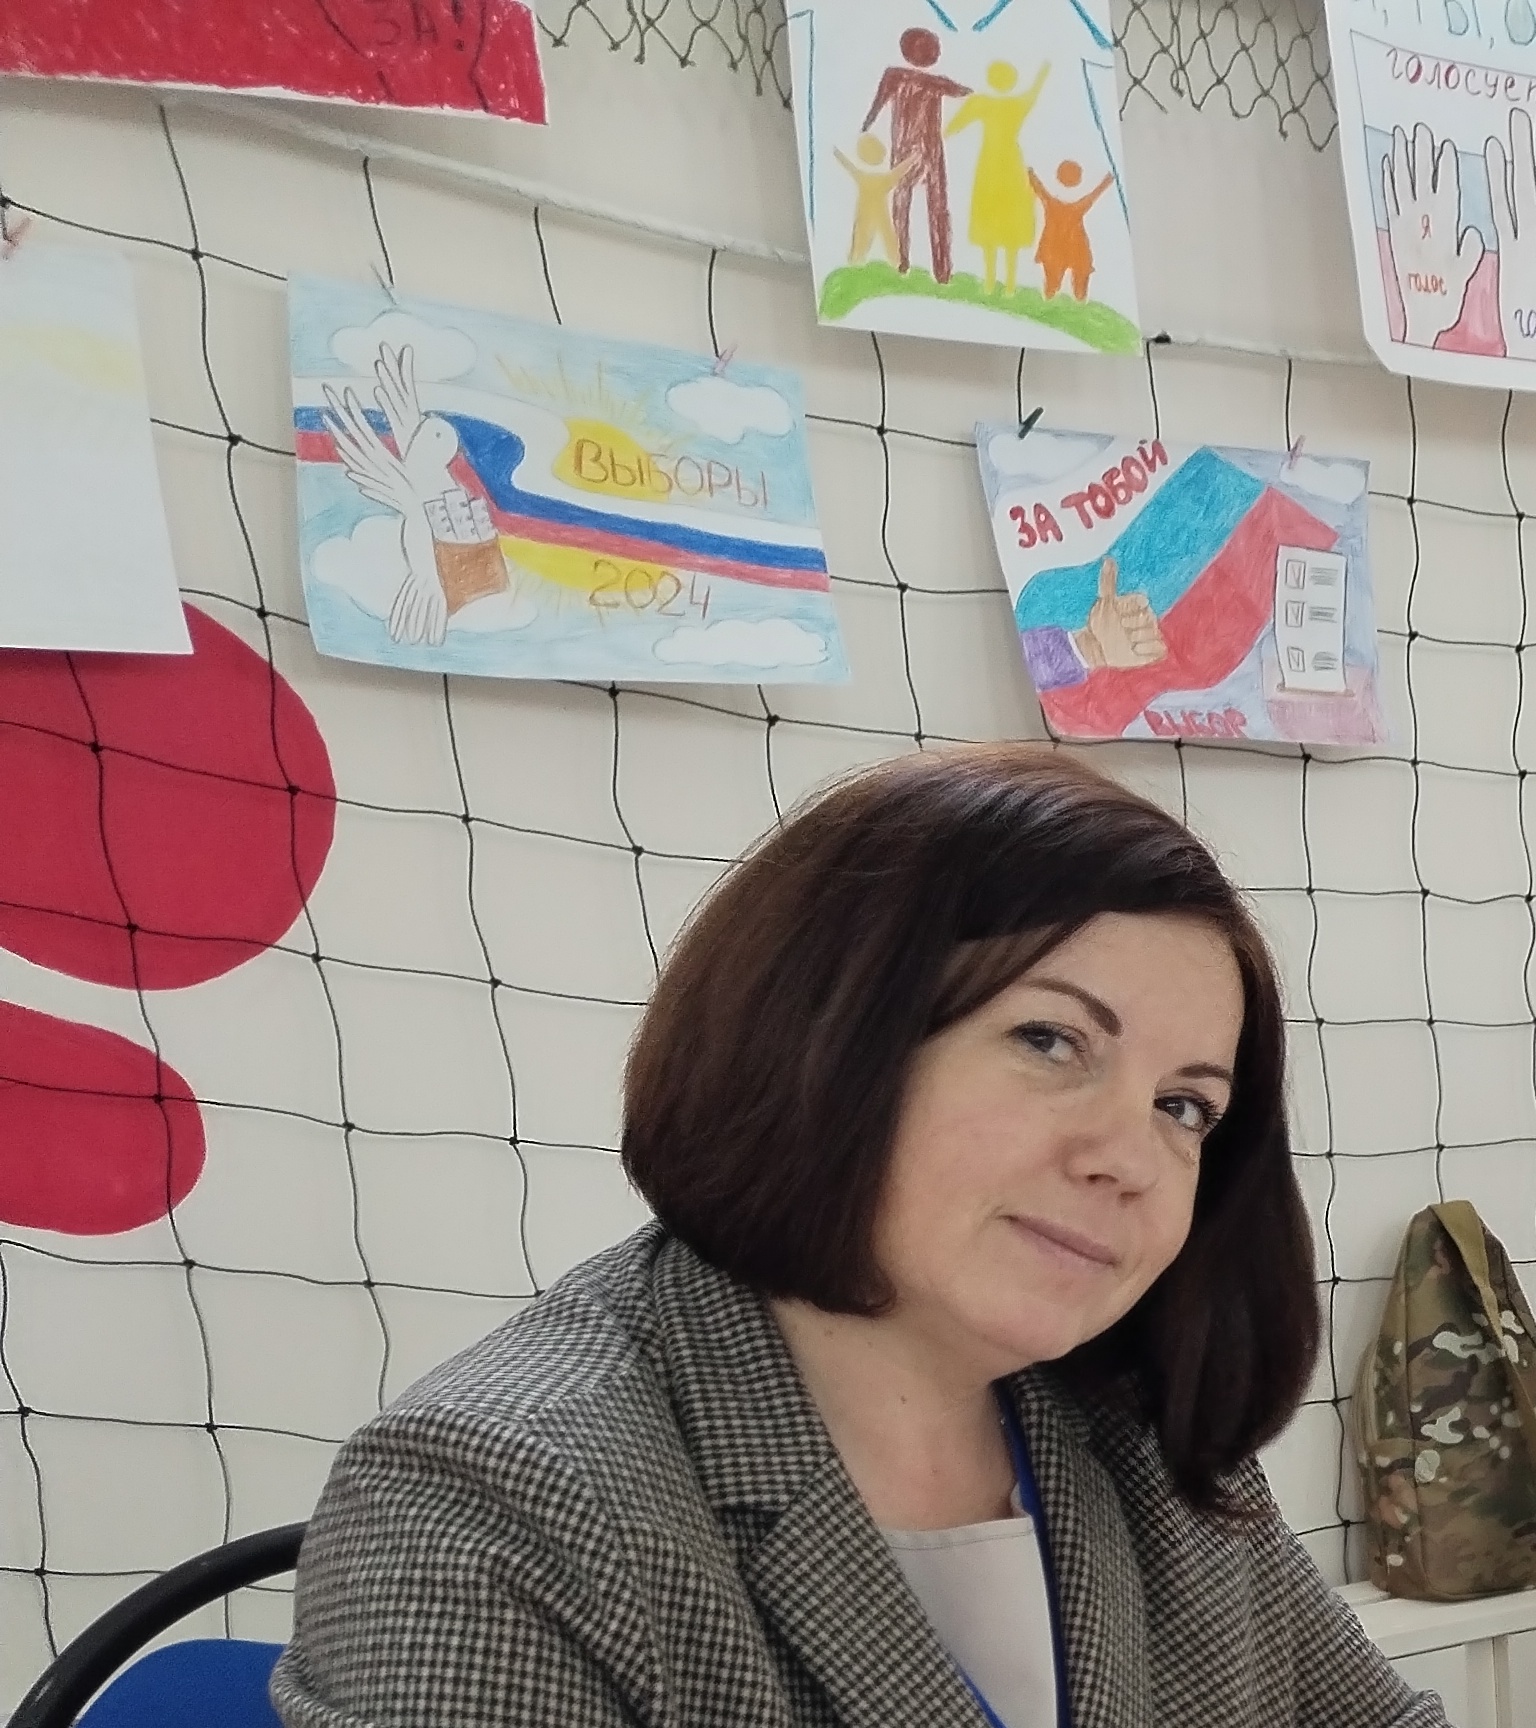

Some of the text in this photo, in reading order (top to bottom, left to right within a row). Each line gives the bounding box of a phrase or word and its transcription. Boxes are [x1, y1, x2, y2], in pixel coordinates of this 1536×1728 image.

[573, 438, 769, 512] ВЫБОРЫ
[1009, 438, 1169, 549] ЗА ТОБОЙ
[588, 559, 712, 621] 2024
